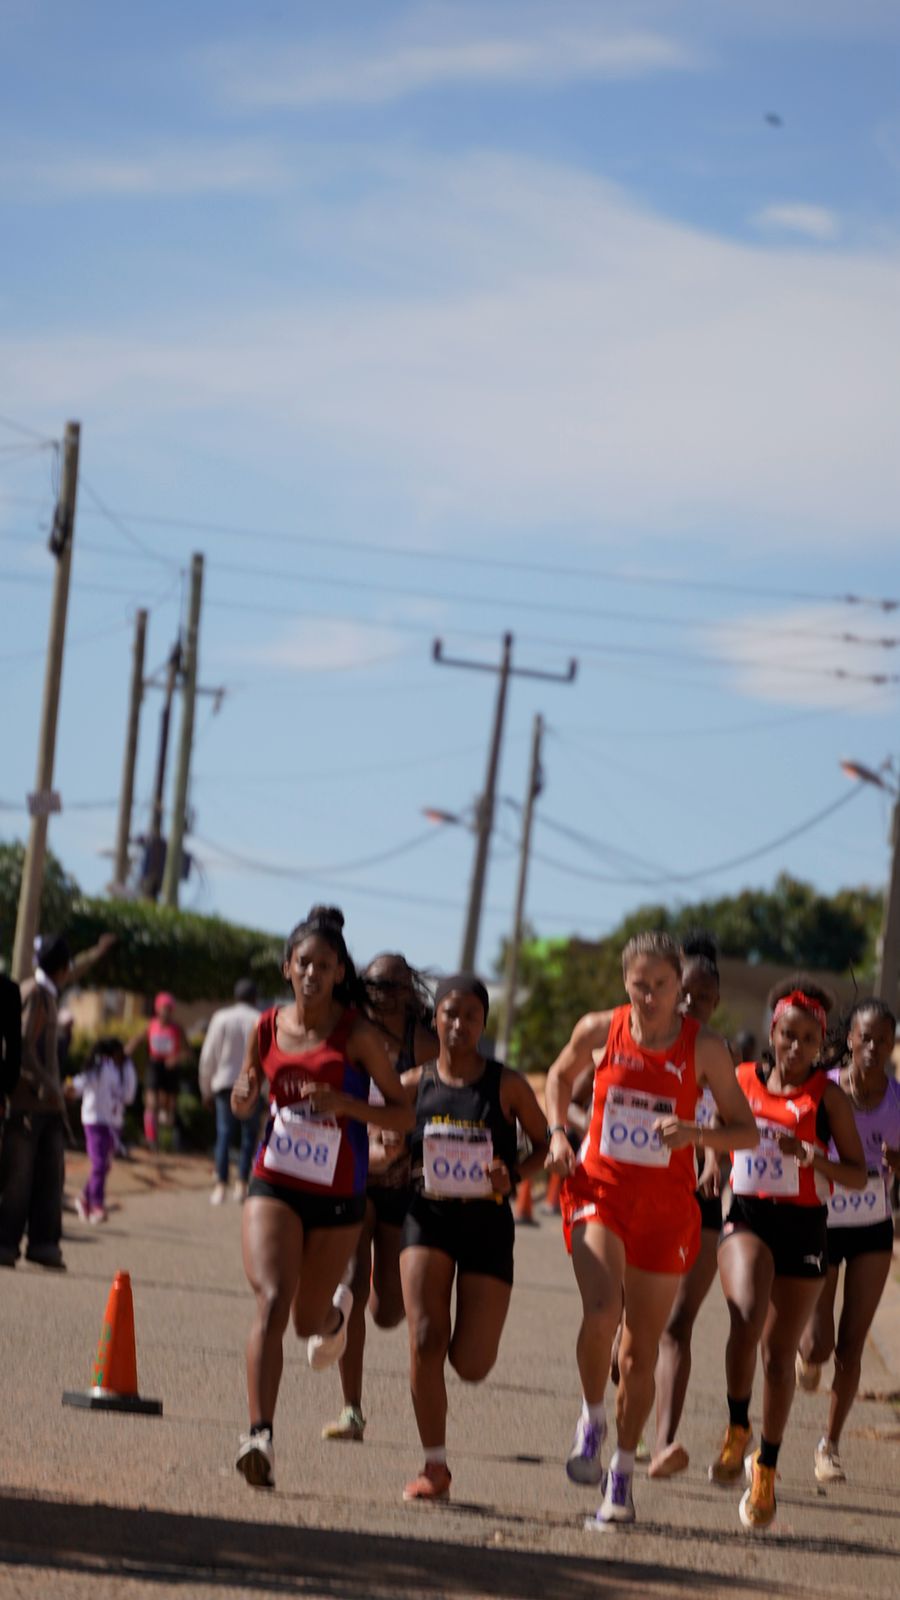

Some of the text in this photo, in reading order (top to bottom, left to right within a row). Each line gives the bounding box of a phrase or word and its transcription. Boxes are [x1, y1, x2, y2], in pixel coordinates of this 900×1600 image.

[433, 1155, 483, 1182] 066
[747, 1156, 783, 1180] 193
[831, 1193, 877, 1213] 099
